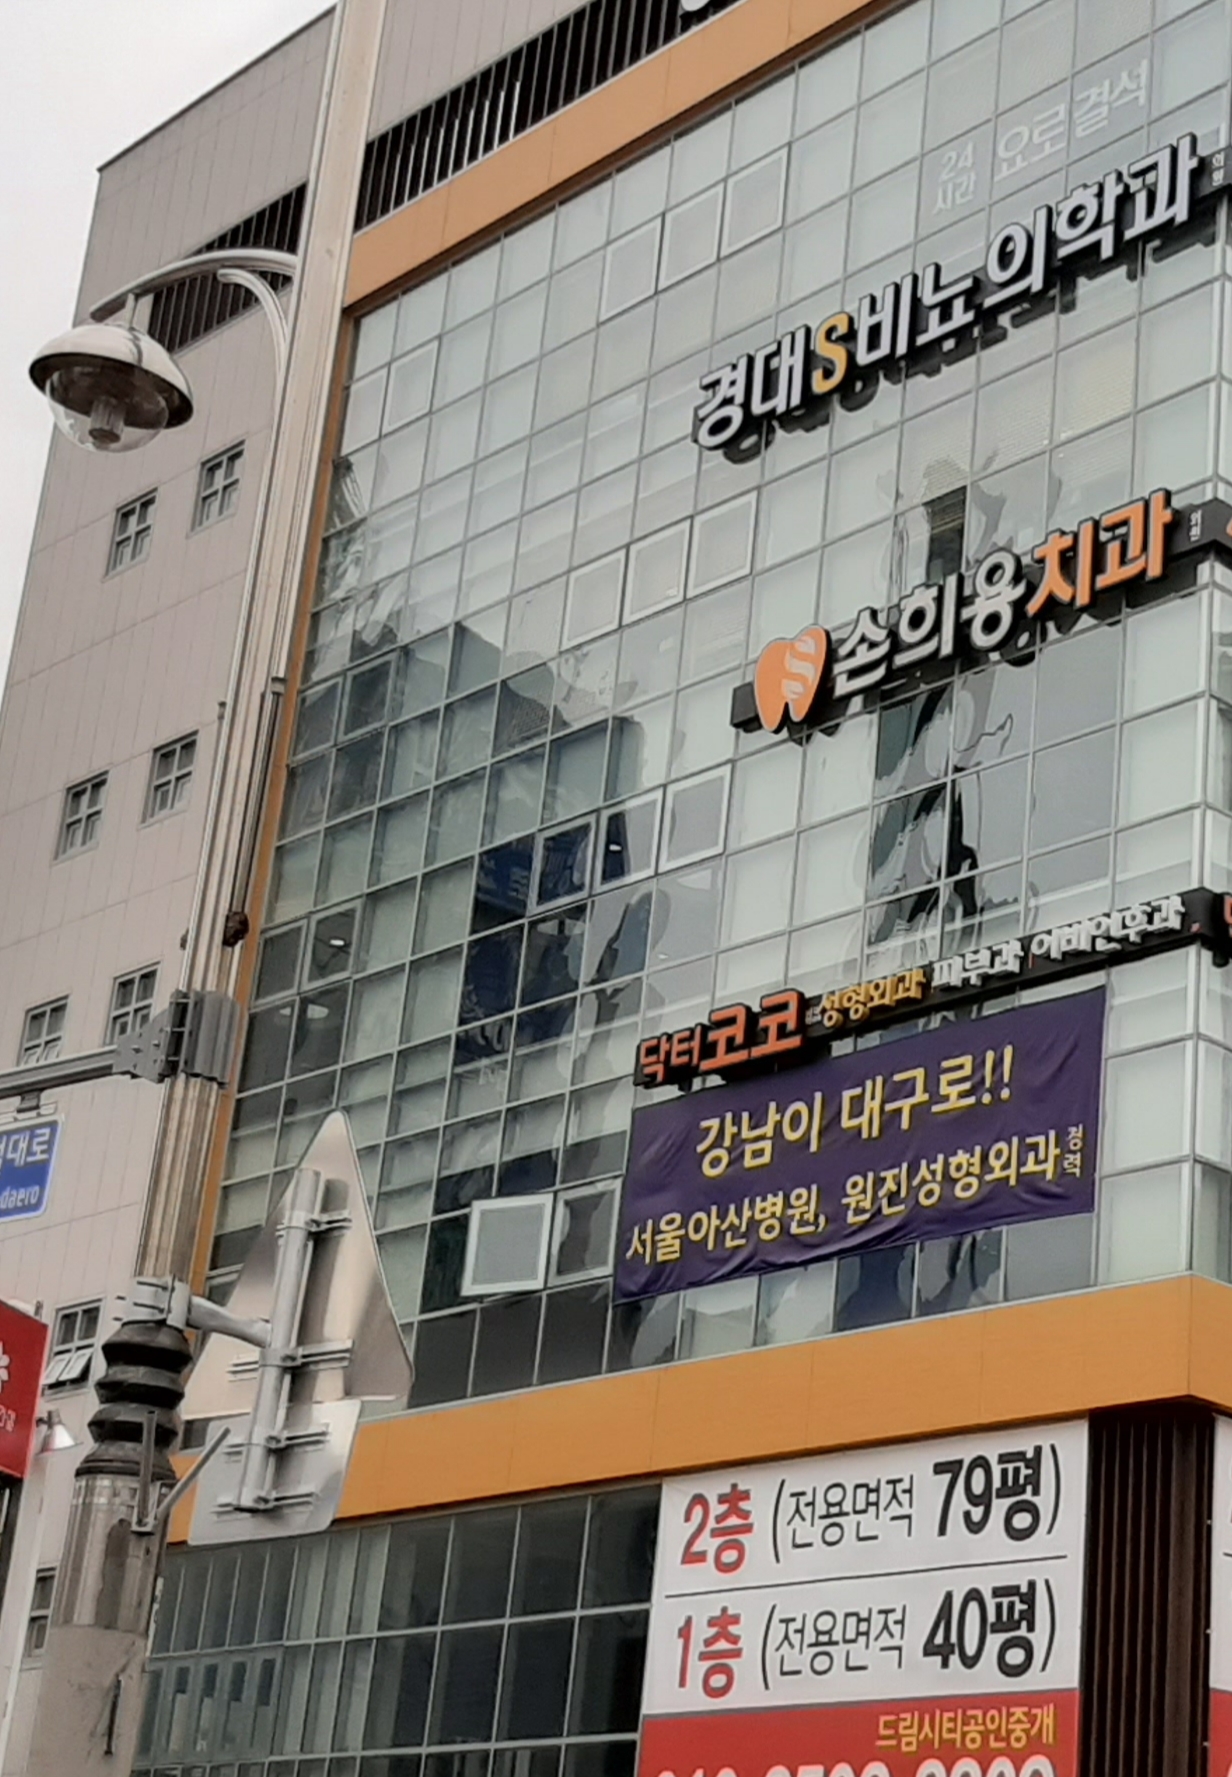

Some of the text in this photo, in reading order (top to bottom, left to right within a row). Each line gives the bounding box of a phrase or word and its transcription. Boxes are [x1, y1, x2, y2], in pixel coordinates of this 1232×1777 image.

[941, 141, 975, 179] 24
[993, 57, 1149, 183] 요로결석
[697, 134, 1198, 449] 경대S비뇨의학과
[640, 990, 803, 1081] 닥터코코
[814, 966, 926, 1028] 성형외과
[931, 939, 1024, 988] 피부과
[696, 1044, 1014, 1179] 강남이 대구로!!
[625, 1183, 826, 1264] 서울아산병원,
[841, 1129, 1060, 1225] 원진성형외과
[680, 1443, 1062, 1574] 2층 (전용면적 79평)
[677, 1578, 1056, 1700] 1층 (전용면적 40평)
[875, 1703, 1056, 1752] 드림시티공인중개
